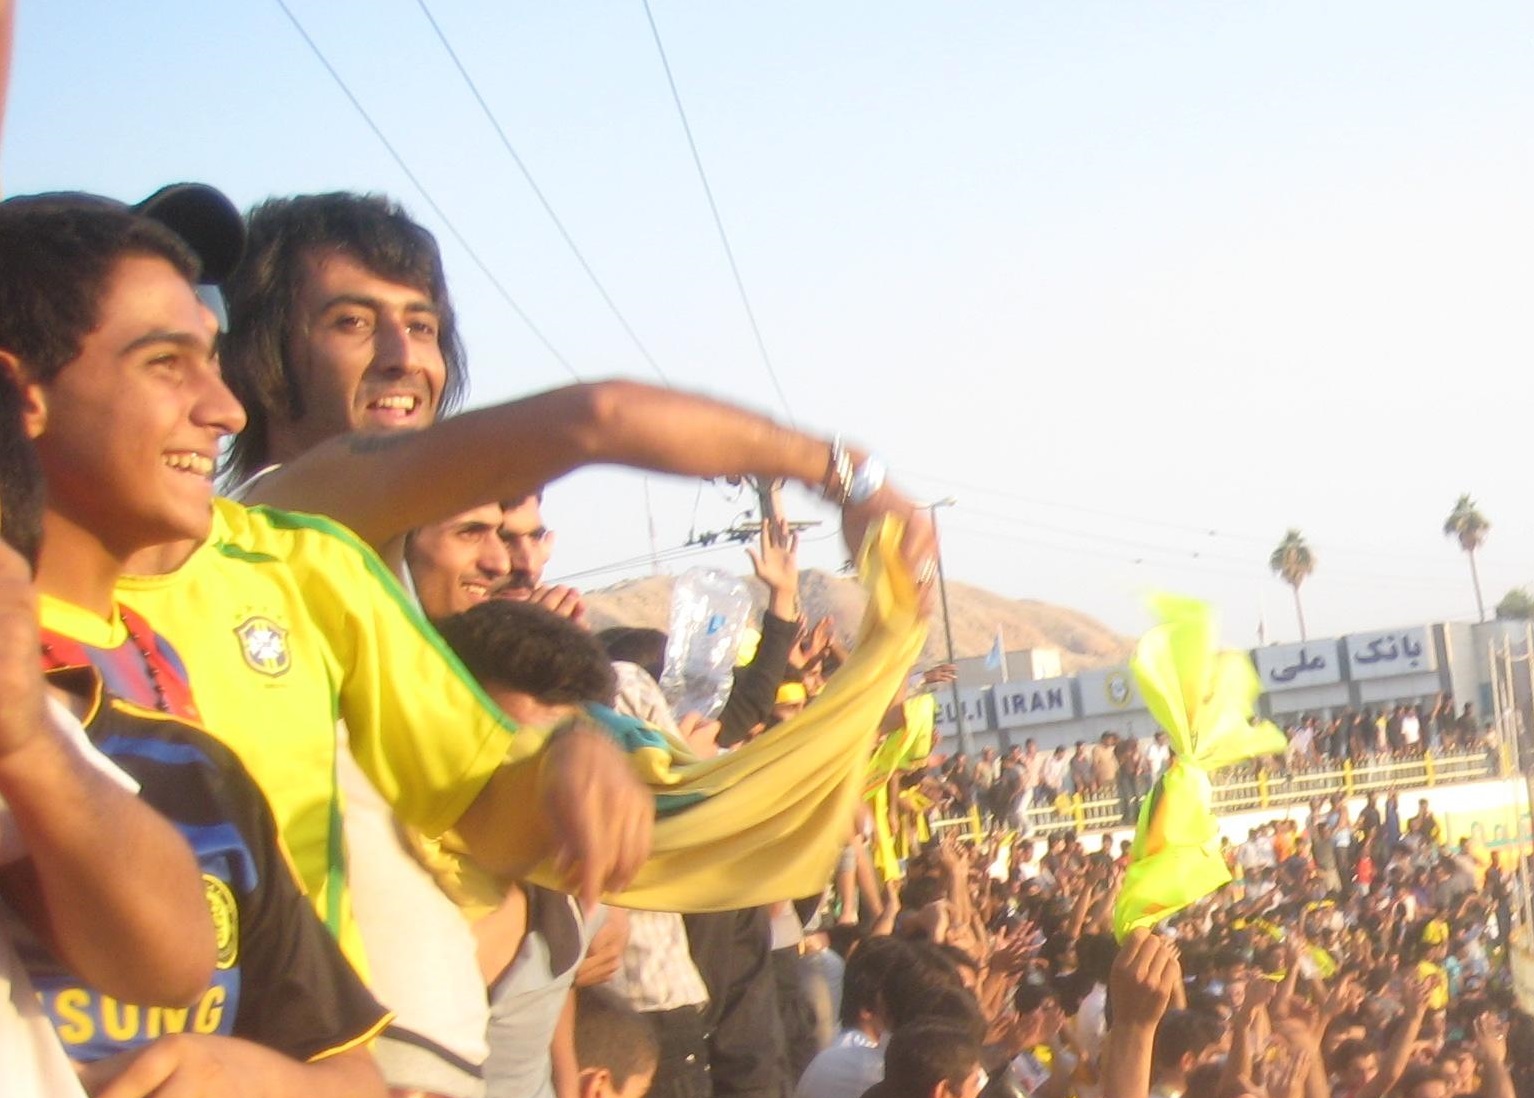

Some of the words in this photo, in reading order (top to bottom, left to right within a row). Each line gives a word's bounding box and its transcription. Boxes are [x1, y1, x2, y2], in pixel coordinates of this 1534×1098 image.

[1270, 648, 1326, 682] ملی
[1354, 634, 1422, 668] بانک
[934, 700, 982, 724] ELLI
[1003, 687, 1064, 716] IRAN
[36, 985, 227, 1045] SUNG
